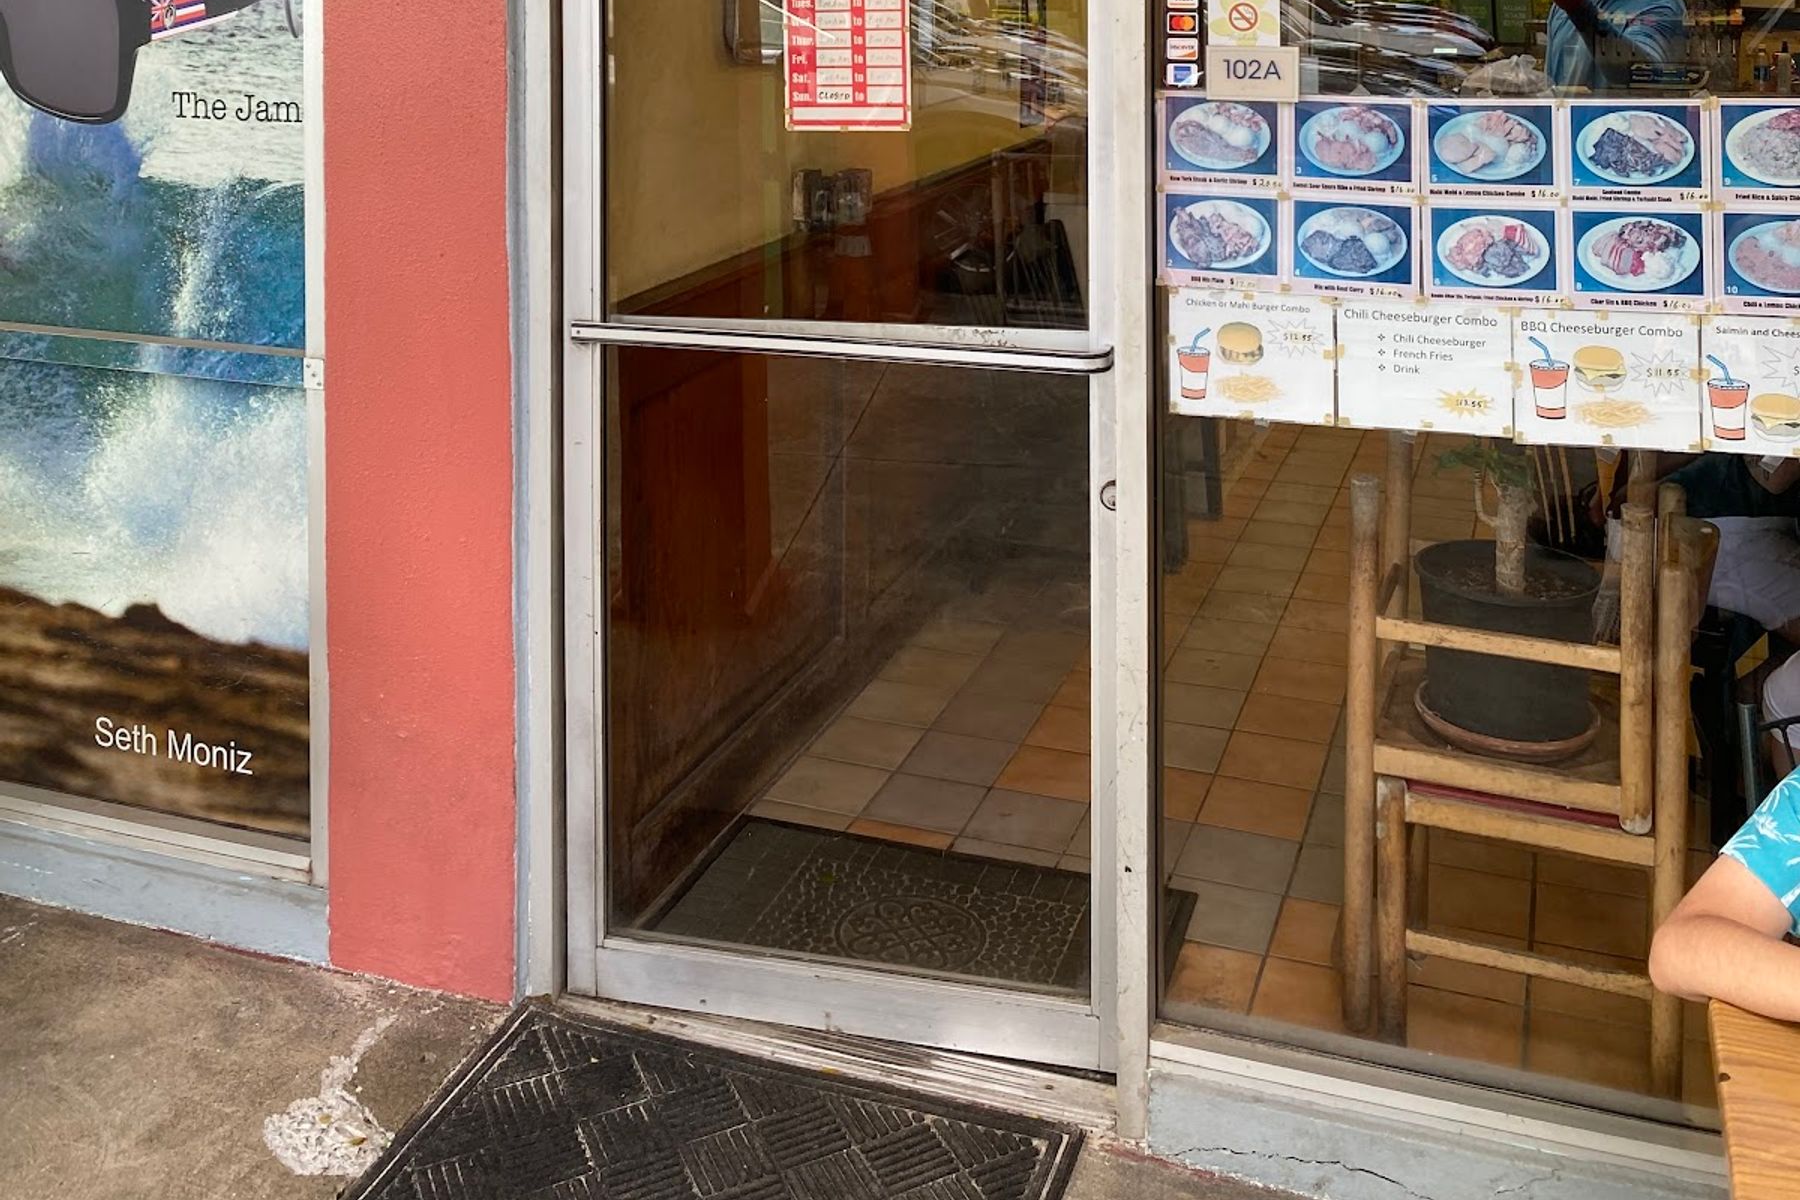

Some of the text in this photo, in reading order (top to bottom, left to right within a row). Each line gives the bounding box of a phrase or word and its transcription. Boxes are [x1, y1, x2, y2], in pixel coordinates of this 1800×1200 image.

[853, 17, 862, 26] to
[854, 36, 863, 45] to
[791, 54, 808, 64] Fri.
[854, 54, 863, 64] to
[1223, 59, 1281, 80] 102A
[792, 73, 811, 83] Sat.
[854, 73, 864, 82] to
[792, 91, 813, 102] Sun.
[855, 91, 864, 101] to
[172, 91, 302, 123] The Jam
[1726, 285, 1738, 294] 10
[1186, 298, 1217, 307] Chicken
[1229, 301, 1249, 309] Mahi
[1252, 302, 1279, 312] Burger
[1281, 304, 1311, 314] Combo
[1344, 308, 1498, 328] Chili Cheeseburger Combo
[1521, 321, 1684, 338] BBQ Cheeseburger Combo
[1751, 328, 1770, 336] and
[1393, 333, 1487, 350] Chili Cheeseburger
[1393, 349, 1454, 362] French Fries
[1393, 364, 1421, 375] Drink
[95, 716, 253, 776] Seth Moniz
